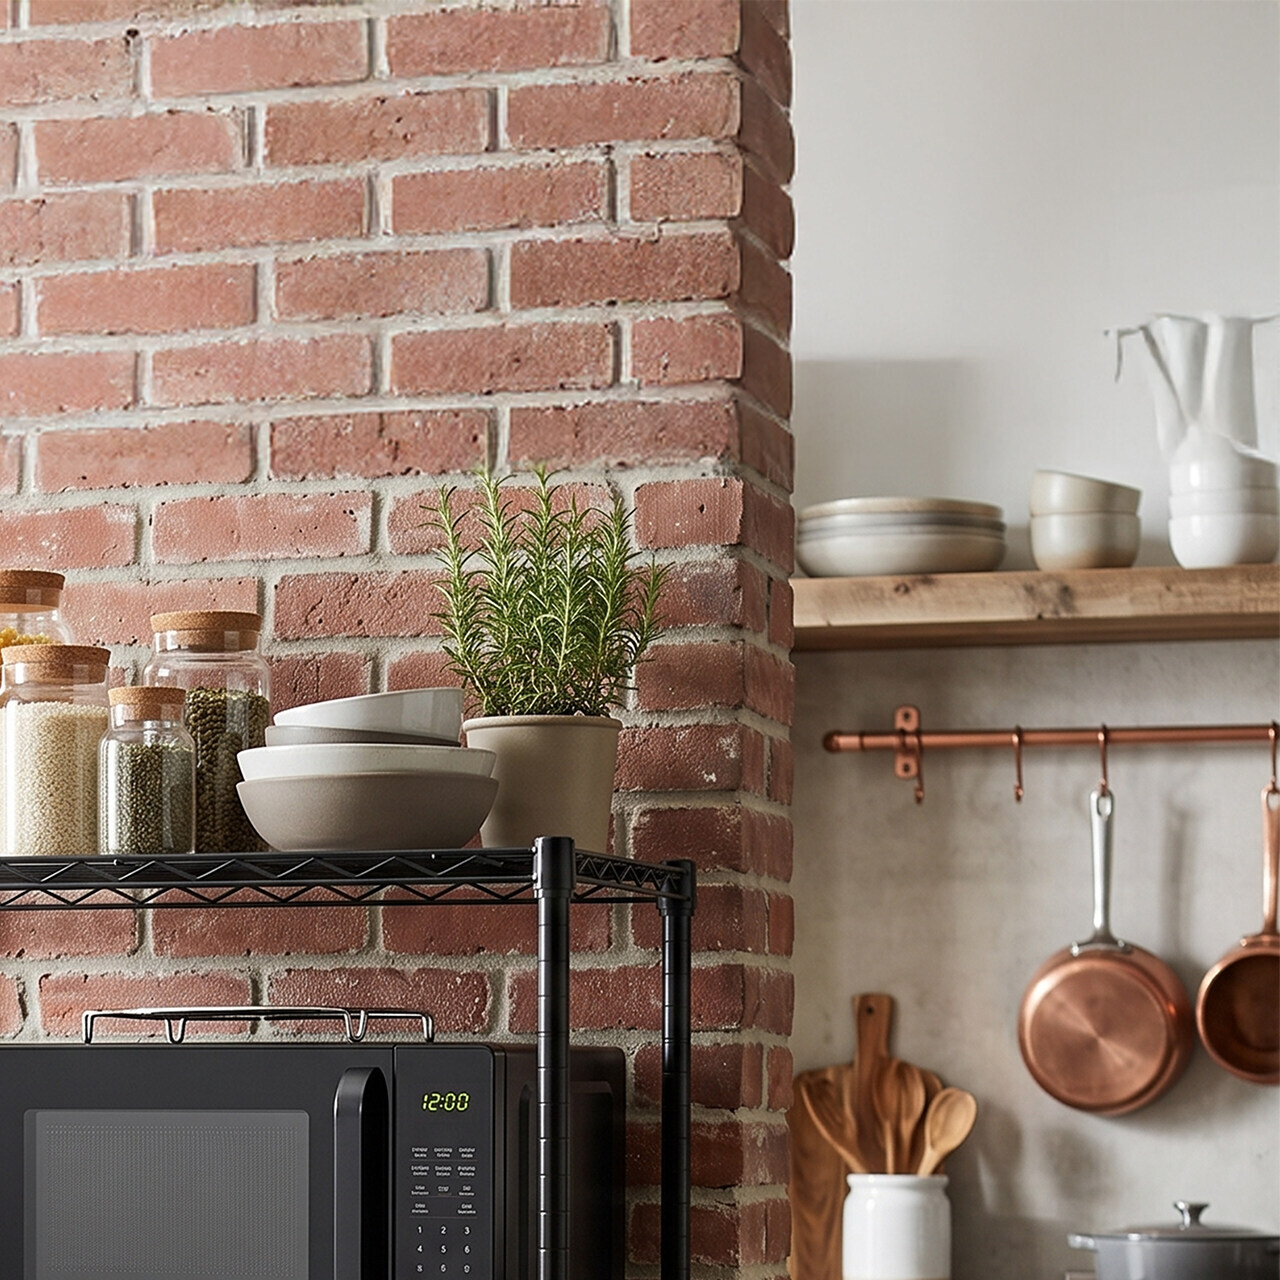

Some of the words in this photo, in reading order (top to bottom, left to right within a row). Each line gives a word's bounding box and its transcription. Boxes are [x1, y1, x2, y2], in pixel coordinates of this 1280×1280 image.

[422, 1092, 469, 1111] 12:00
[440, 1225, 447, 1235] 2
[464, 1226, 470, 1235] 3
[464, 1245, 470, 1254] 6
